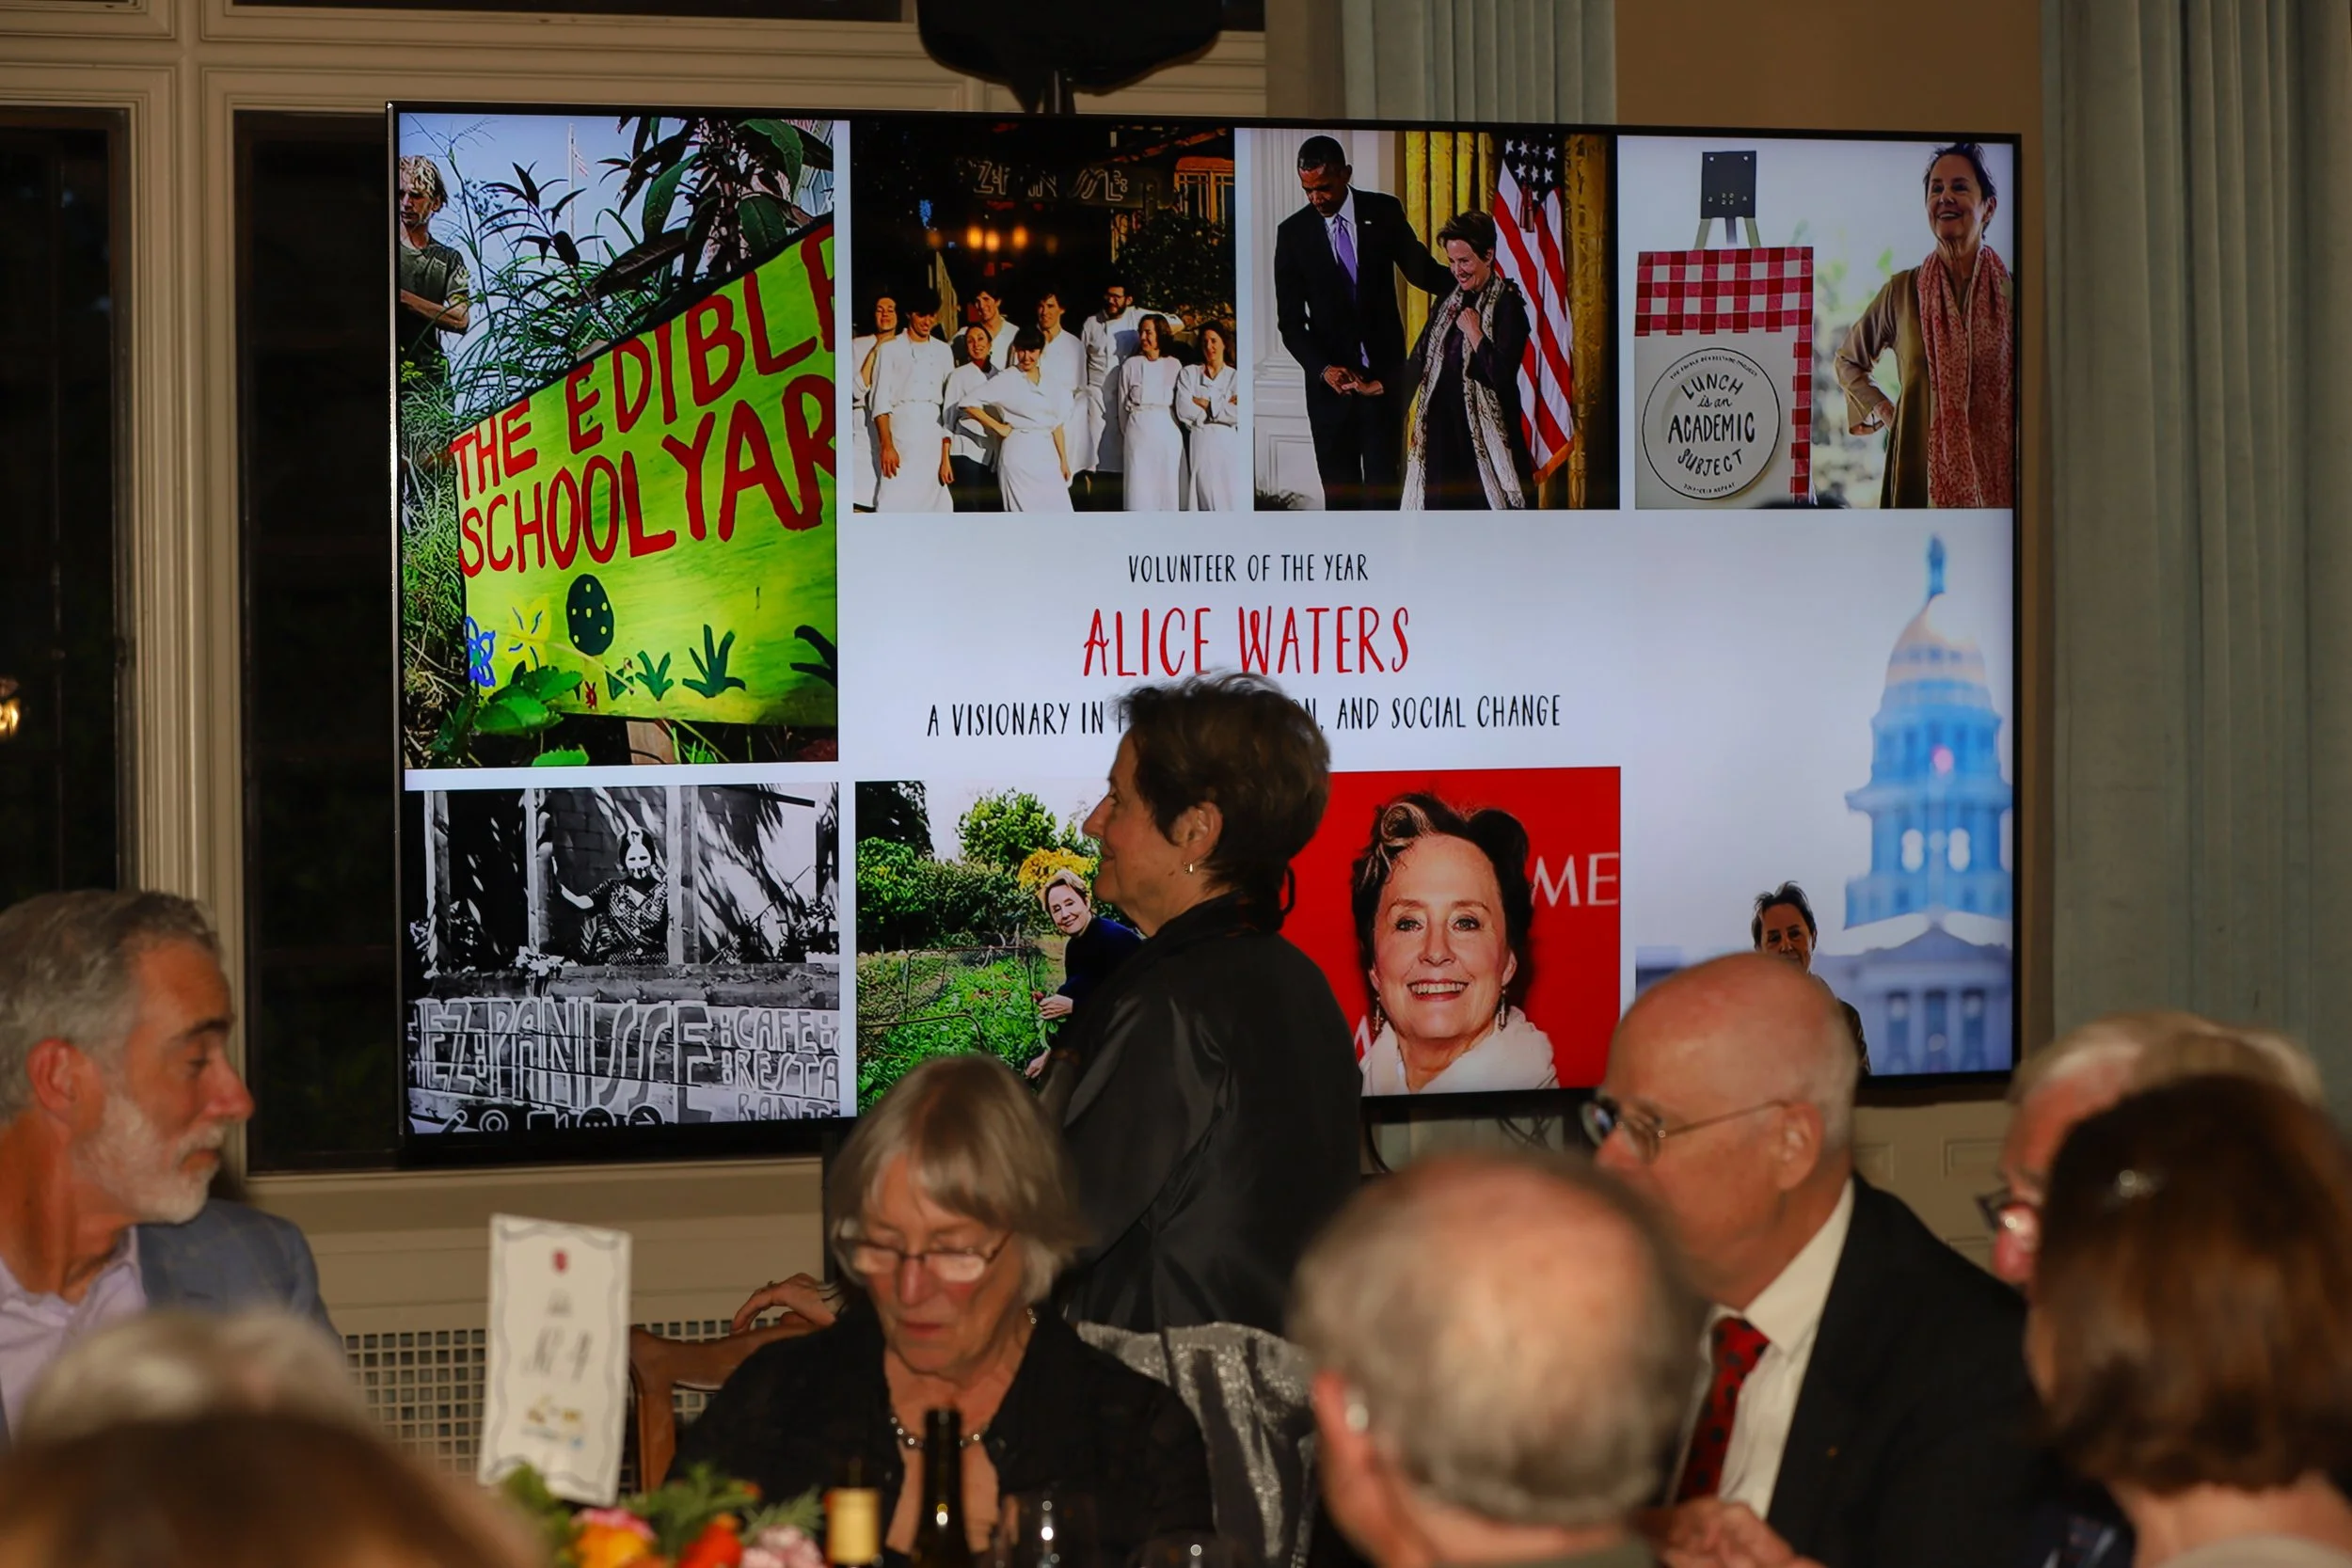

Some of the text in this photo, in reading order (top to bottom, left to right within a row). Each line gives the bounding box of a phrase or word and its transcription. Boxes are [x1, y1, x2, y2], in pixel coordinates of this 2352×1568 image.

[1681, 373, 1744, 400] LUNCH
[1697, 395, 1732, 408] is an
[1668, 412, 1756, 444] ACADEMIC
[451, 398, 538, 500] THE
[1677, 448, 1742, 477] SUBJECT
[1128, 553, 1369, 583] VOLUNTEER OF THE YEAR
[1083, 605, 1409, 677] ALICE WATERS
[927, 704, 939, 736] A
[952, 702, 1070, 736] VISIONARY
[1081, 701, 1104, 735] IN
[1337, 697, 1379, 730] AND
[1391, 696, 1467, 729] SOCIAL
[1476, 694, 1561, 728] CHANGE
